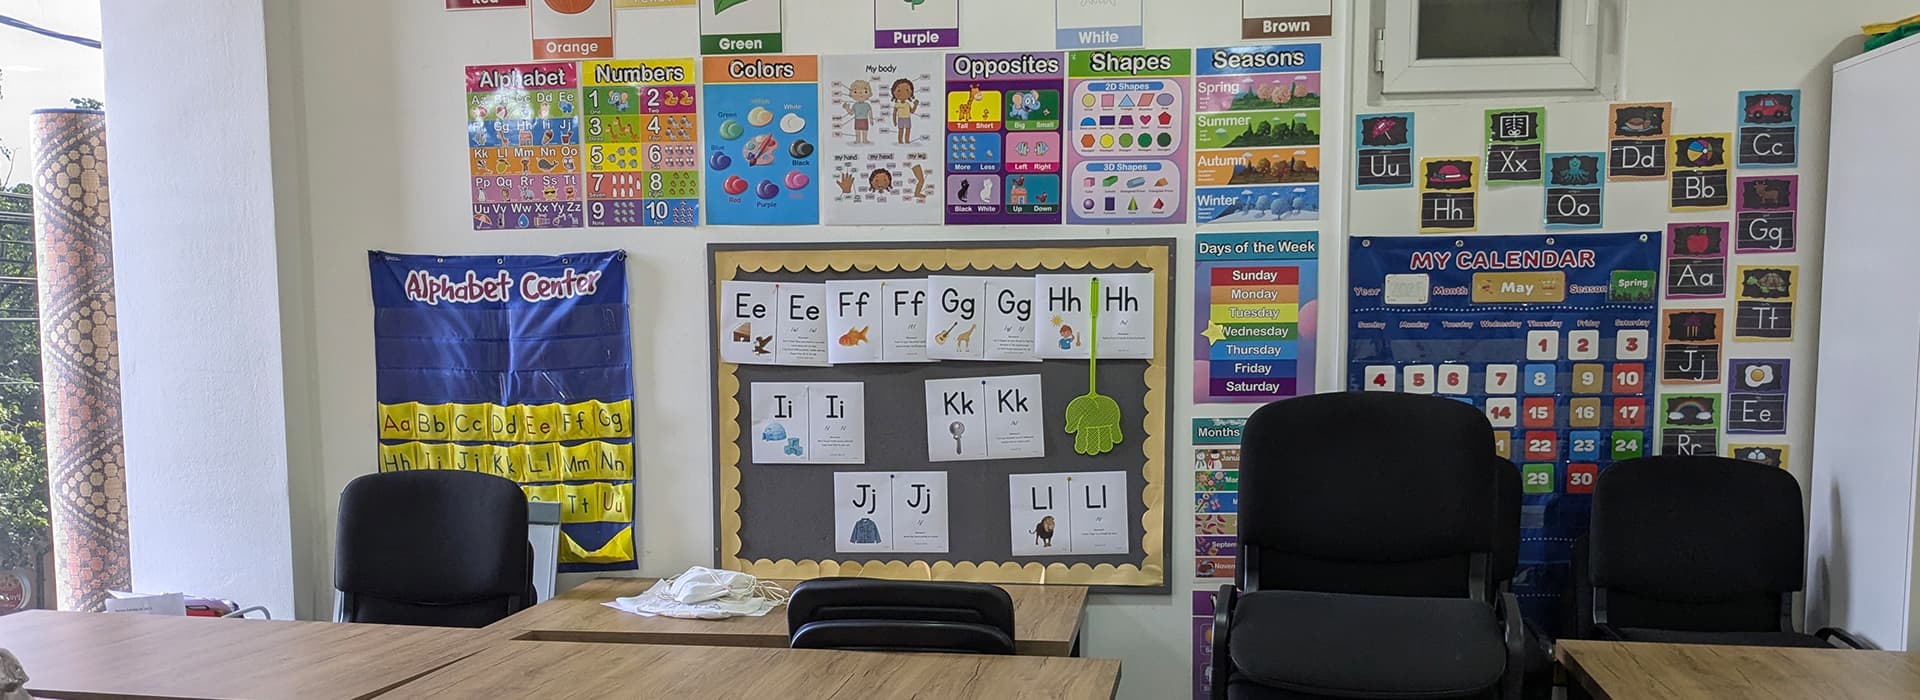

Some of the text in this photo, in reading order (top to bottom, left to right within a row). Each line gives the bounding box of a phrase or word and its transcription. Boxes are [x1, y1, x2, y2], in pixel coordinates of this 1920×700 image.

[1263, 20, 1310, 33] Brown
[719, 38, 762, 50] Green
[894, 32, 940, 46] Purple
[1078, 31, 1119, 44] White
[546, 42, 598, 55] Orange
[866, 64, 897, 73] My body
[954, 56, 1059, 79] Opposites
[1091, 52, 1172, 75] Shapes
[1213, 50, 1305, 69] Seasons
[596, 64, 684, 83] Numbers
[730, 60, 794, 78] Colors
[480, 69, 566, 88] Alphabet
[1118, 83, 1149, 91] Shapes
[647, 88, 660, 107] 2
[1198, 81, 1240, 96] Spring
[589, 90, 598, 108] 1
[589, 117, 602, 136] 3
[647, 116, 661, 134] 4
[1198, 116, 1251, 127] Summer
[474, 149, 488, 158] Kk
[514, 148, 534, 157] Mm
[540, 148, 556, 156] Nn
[561, 147, 578, 156] Oo
[1753, 133, 1783, 156] Cc
[590, 146, 603, 164] 5
[648, 144, 661, 164] 6
[1197, 156, 1246, 167] Autumn
[1500, 151, 1528, 172] Xx
[1622, 145, 1656, 168] Dd
[1116, 164, 1148, 172] Shapes
[1370, 155, 1400, 177] Uu
[591, 174, 604, 192] 7
[649, 172, 662, 191] 8
[1686, 176, 1715, 199] Bb
[1197, 195, 1238, 206] Winter
[1434, 198, 1464, 220] Hh
[1558, 194, 1590, 216] Oo
[592, 202, 605, 220] 9
[646, 201, 668, 219] 10
[1749, 218, 1782, 250] Gg
[1199, 240, 1315, 256] Days of the Week
[1410, 249, 1595, 270] MY CALENDAR
[1232, 270, 1278, 282] Sunday
[1618, 278, 1648, 289] Spring
[1677, 264, 1713, 286] Aa
[406, 270, 600, 304] Alphabet Center
[1231, 289, 1278, 300] Monday
[1354, 286, 1380, 296] Year
[1433, 286, 1468, 295] Month
[1500, 282, 1534, 295] May
[1570, 284, 1608, 294] Season
[736, 293, 766, 319] Ee
[790, 295, 820, 320] Ee
[839, 292, 870, 317] Ff
[894, 291, 926, 316] Ff
[942, 288, 975, 320] Gg
[998, 289, 1032, 322] Gg
[1049, 286, 1081, 312] Hh
[1106, 286, 1138, 312] Hh
[1230, 308, 1280, 319] Tuesday
[1752, 307, 1778, 329] Tt
[1358, 319, 1650, 330] Sunday Monday Tuesday Wednesday Thursday Friday Saturday
[1226, 344, 1282, 356] Thursday
[1538, 339, 1547, 352] 1
[1577, 339, 1589, 352] 2
[1626, 337, 1638, 352] 3
[1234, 363, 1272, 375] Friday
[1679, 350, 1705, 382] Jj
[1226, 382, 1280, 393] Saturday
[1373, 373, 1386, 387] 4
[1413, 373, 1425, 386] 5
[1447, 372, 1460, 386] 6
[1495, 372, 1508, 386] 7
[1534, 372, 1546, 386] 8
[1582, 372, 1594, 386] 9
[1616, 372, 1639, 386] 10
[774, 395, 792, 418] Ii
[826, 395, 844, 418] Ii
[944, 391, 974, 415] Kk
[998, 388, 1028, 413] Kk
[1490, 406, 1511, 420] 14
[1528, 406, 1548, 420] 15
[1575, 406, 1594, 419] 16
[1620, 406, 1639, 419] 17
[1742, 400, 1771, 422] Ee
[384, 409, 622, 435] Aa Bb Cc Dd Ee Ff Gg
[1198, 427, 1240, 438] Months
[1528, 439, 1552, 452] 22
[1573, 439, 1594, 452] 23
[1615, 439, 1638, 452] 24
[1678, 434, 1702, 456] Rr
[384, 454, 410, 471] Hh
[493, 455, 516, 473] Kk
[528, 452, 552, 472] Ll
[564, 455, 590, 472] Mm
[601, 451, 624, 472] Nn
[1527, 472, 1549, 486] 29
[1570, 472, 1593, 486] 30
[568, 492, 623, 514] Tt Uu
[852, 484, 876, 514] Jj
[907, 484, 930, 514] Jj
[1032, 486, 1052, 510] Ll
[1086, 485, 1106, 508] Ll
